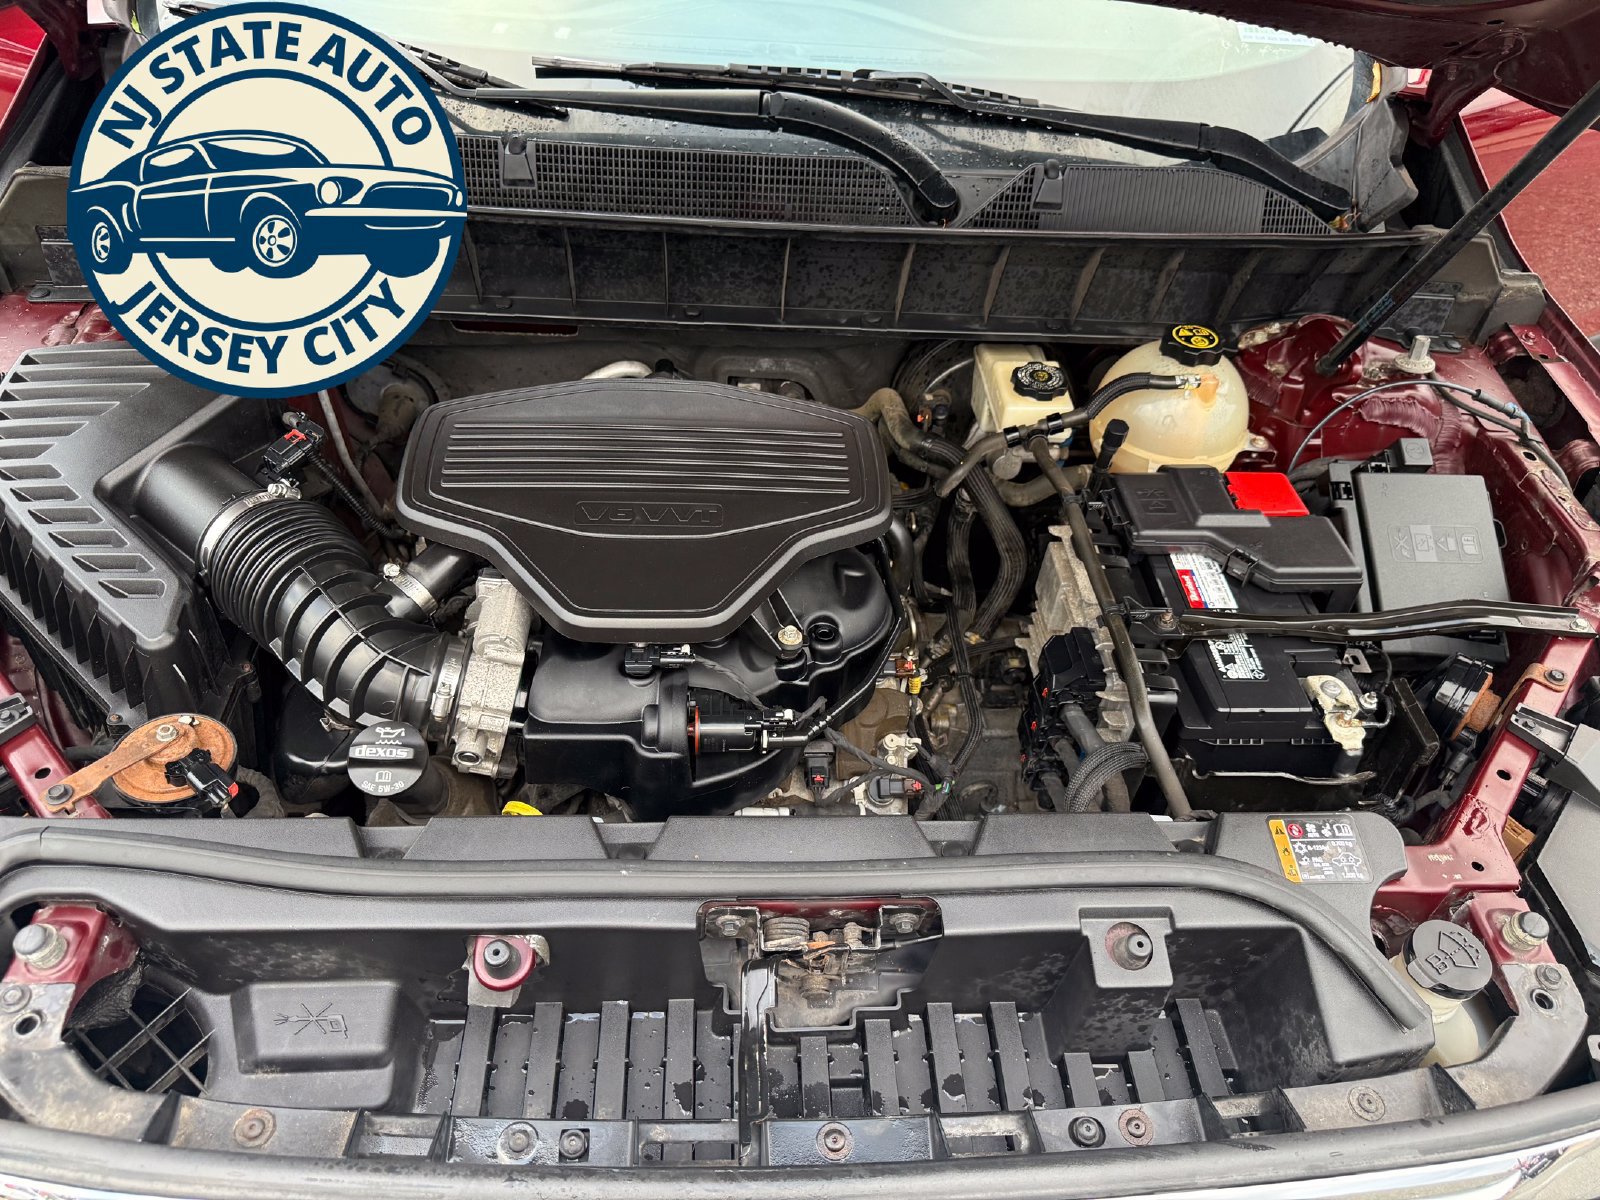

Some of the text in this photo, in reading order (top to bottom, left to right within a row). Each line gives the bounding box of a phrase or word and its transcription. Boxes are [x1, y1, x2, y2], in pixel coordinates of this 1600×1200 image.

[581, 506, 718, 522] V6 VVT
[355, 744, 408, 758] dexos
[361, 780, 405, 793] SAE 5W-30
